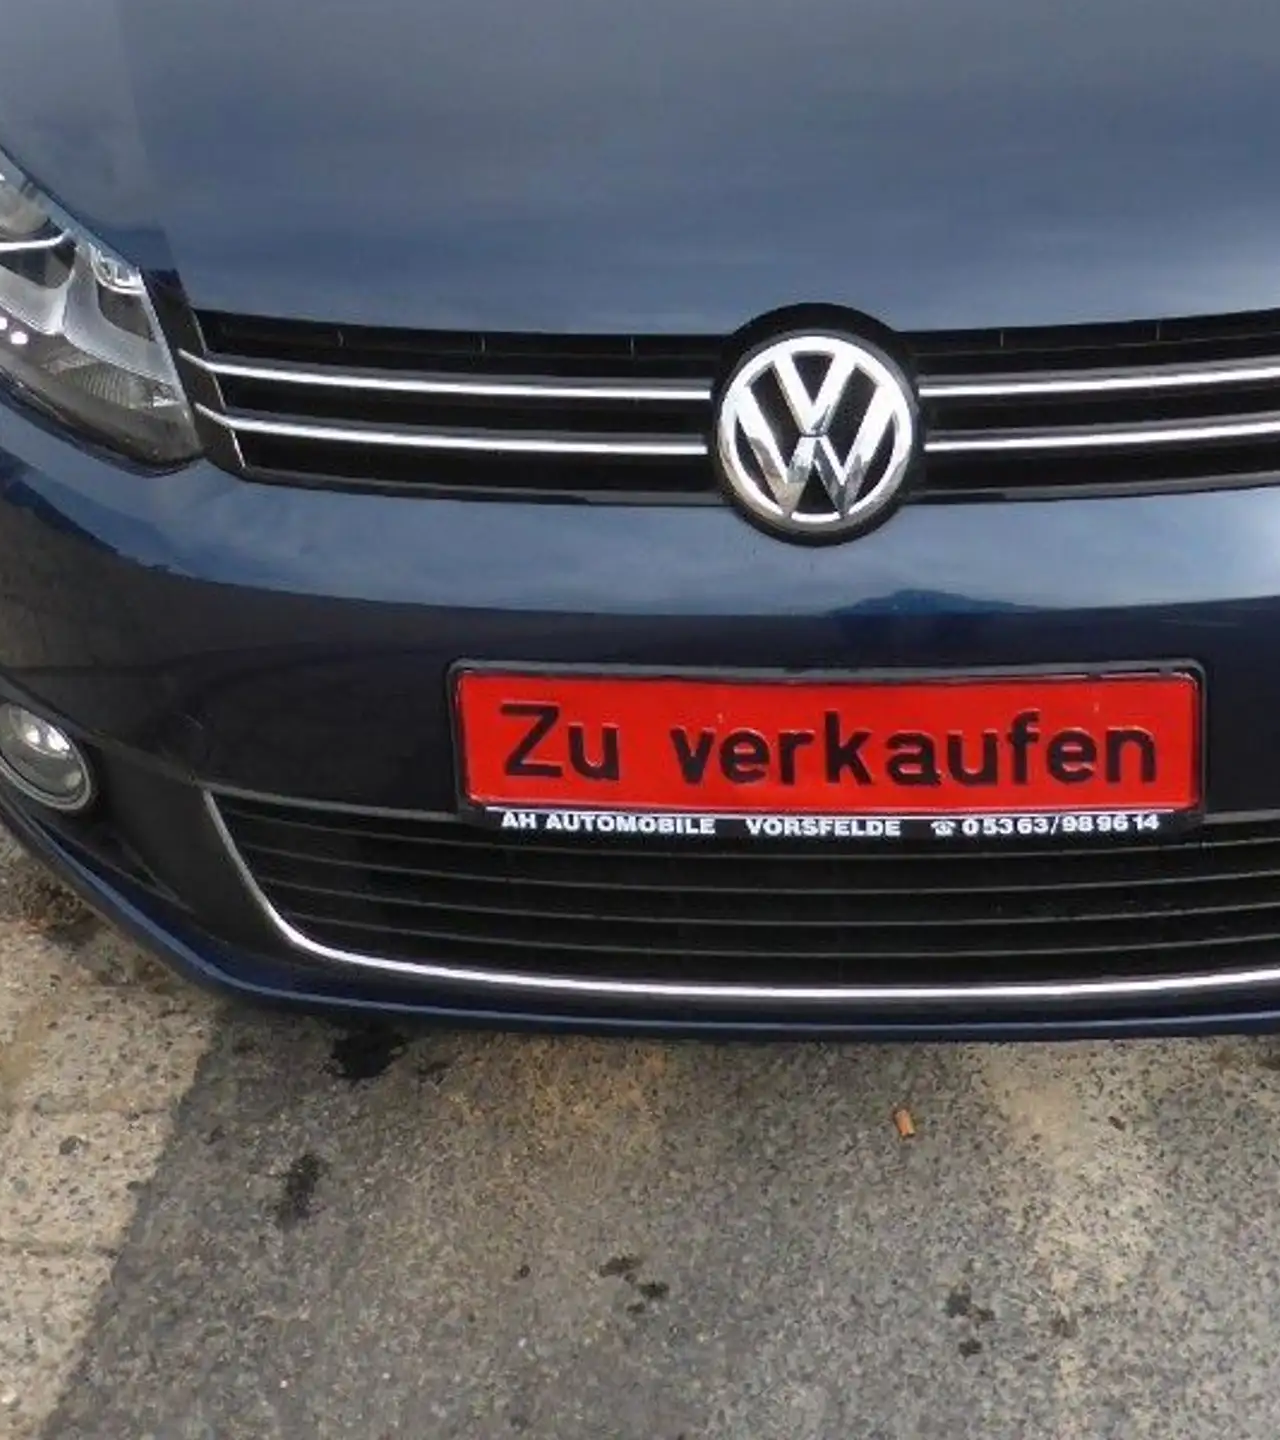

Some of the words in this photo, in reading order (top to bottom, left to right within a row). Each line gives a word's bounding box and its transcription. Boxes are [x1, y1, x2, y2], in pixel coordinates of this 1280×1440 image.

[721, 336, 913, 530] VW
[500, 699, 620, 781] Zu
[670, 708, 1157, 787] verkaufen
[501, 812, 537, 830] AH
[546, 814, 717, 835] AUTOMOBILE
[745, 817, 901, 837] VORSFELDE
